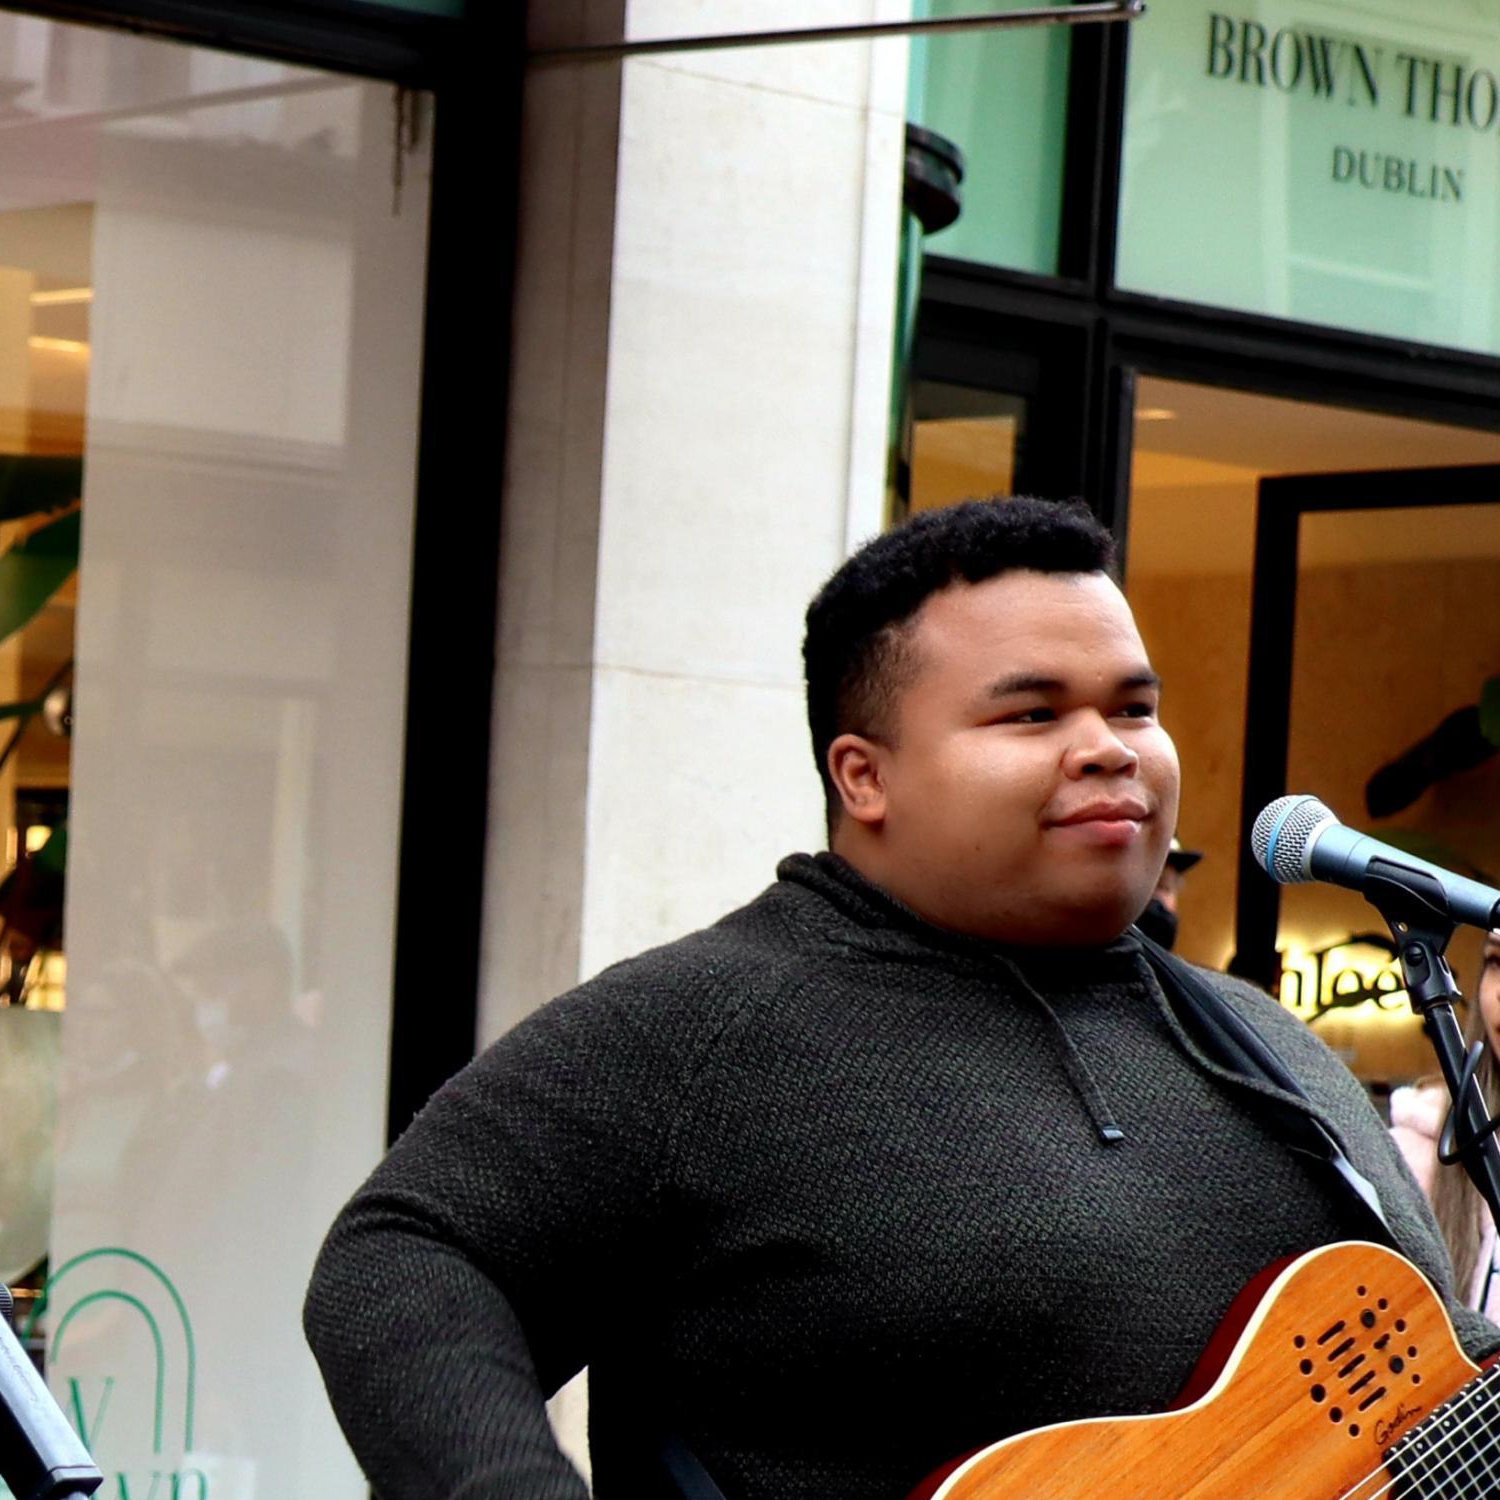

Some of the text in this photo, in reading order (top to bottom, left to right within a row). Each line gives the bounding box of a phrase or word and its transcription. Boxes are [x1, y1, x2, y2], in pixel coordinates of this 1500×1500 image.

[1206, 12, 1500, 133] BROWN THO
[1331, 144, 1464, 202] DUBLIN
